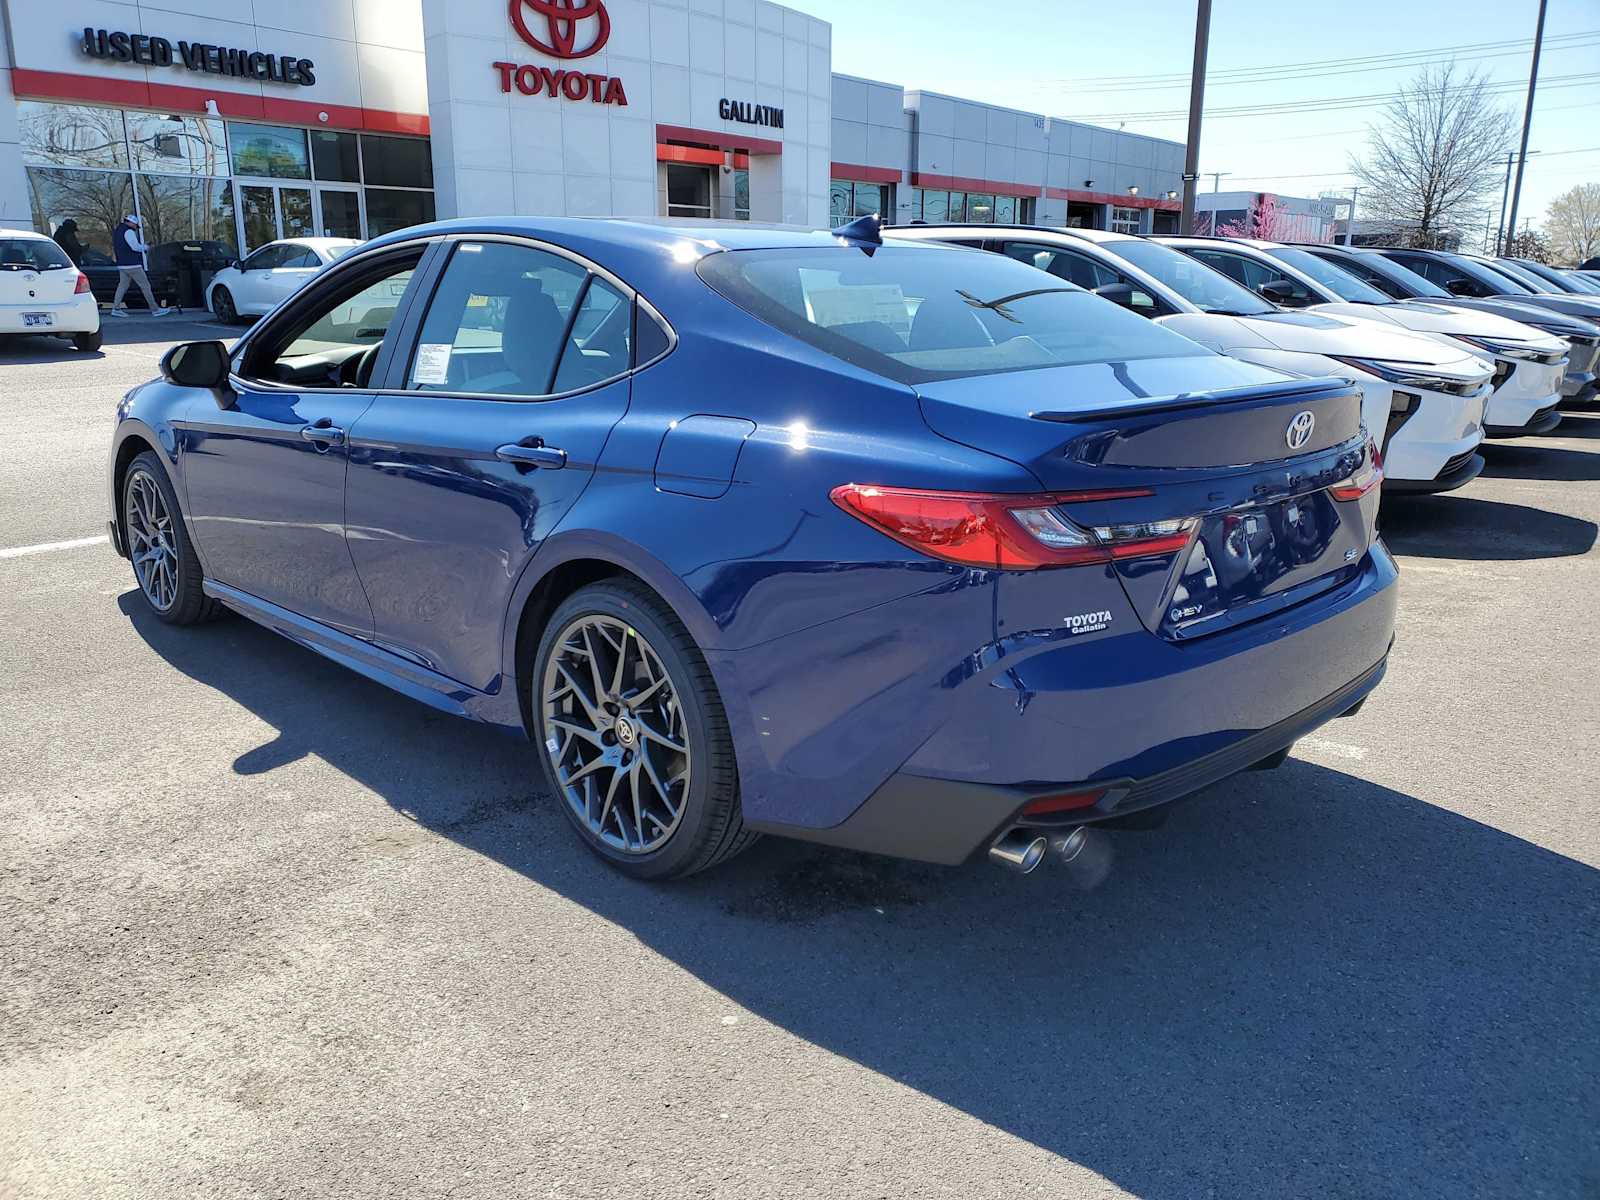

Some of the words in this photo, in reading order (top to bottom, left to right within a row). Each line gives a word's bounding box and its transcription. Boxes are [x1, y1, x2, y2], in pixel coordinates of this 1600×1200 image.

[83, 27, 173, 67] USED
[177, 40, 316, 86] VEHICLES
[493, 61, 628, 106] TOYOTA
[719, 98, 784, 129] GALLATIN
[1064, 610, 1113, 628] TOYOTA
[1071, 622, 1107, 635] Gallatin
